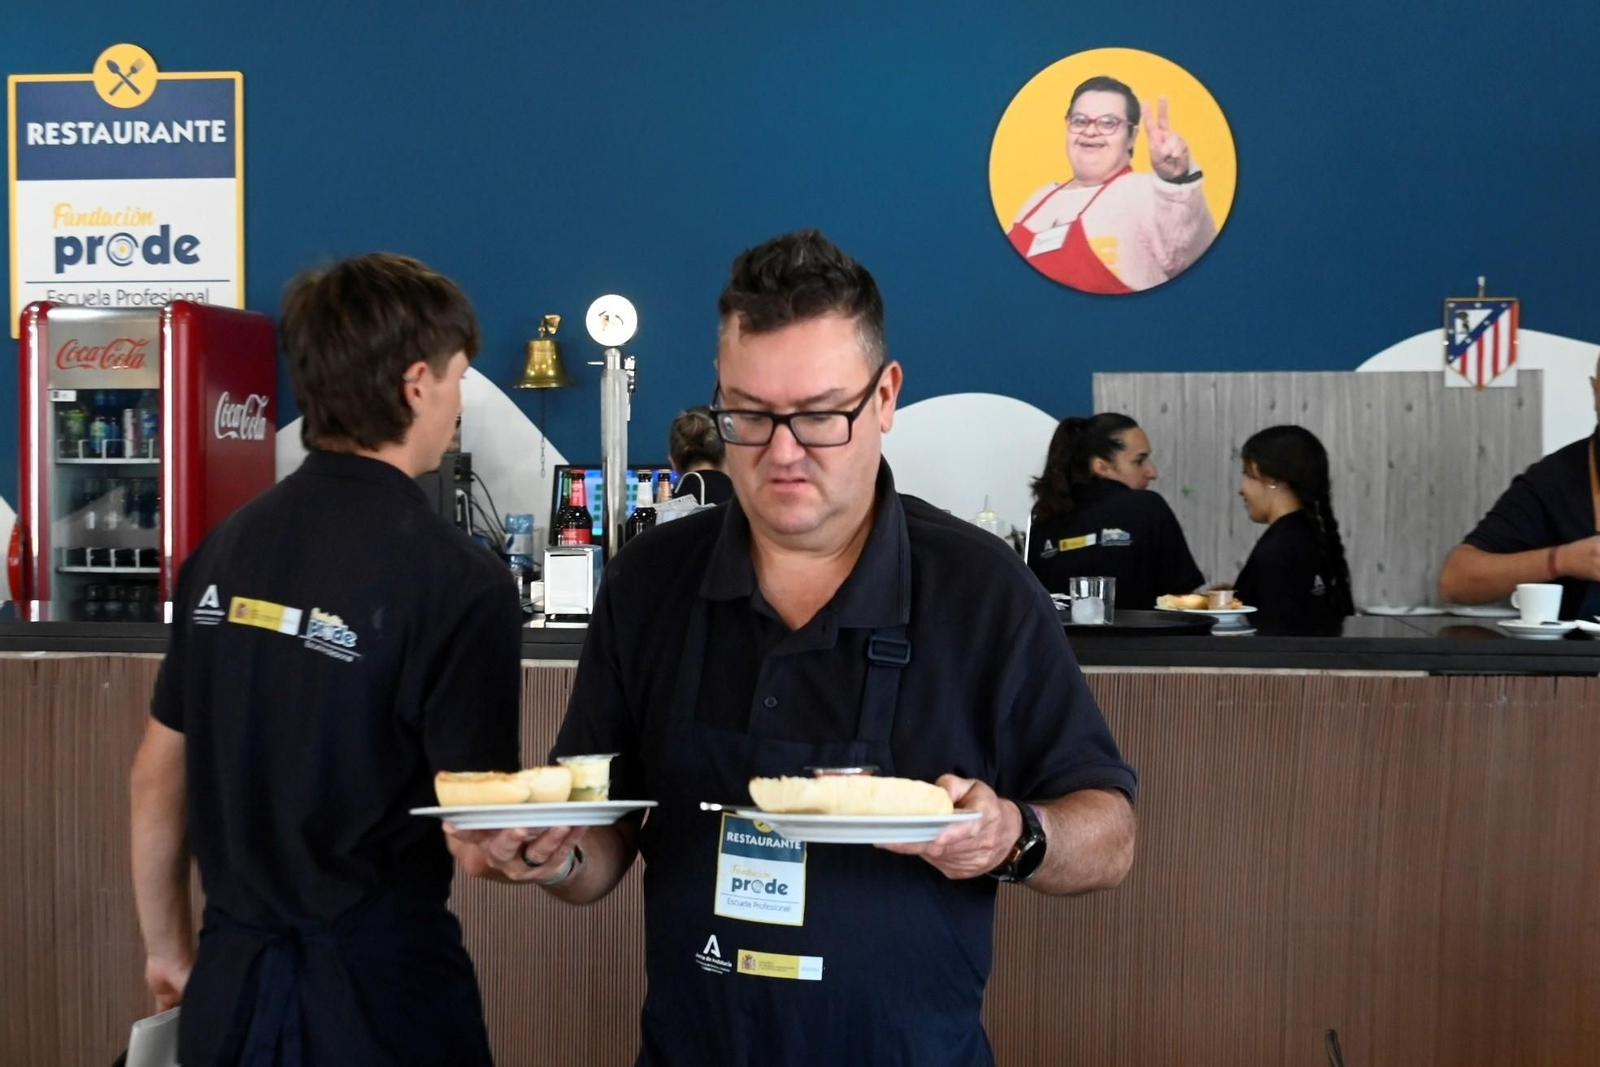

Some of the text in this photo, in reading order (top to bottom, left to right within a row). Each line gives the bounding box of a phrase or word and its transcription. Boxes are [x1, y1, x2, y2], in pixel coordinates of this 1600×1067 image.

[26, 119, 227, 146] RESTAURANTE
[54, 224, 201, 275] prode
[726, 831, 802, 850] RESTAURANTE
[731, 877, 789, 896] prode
